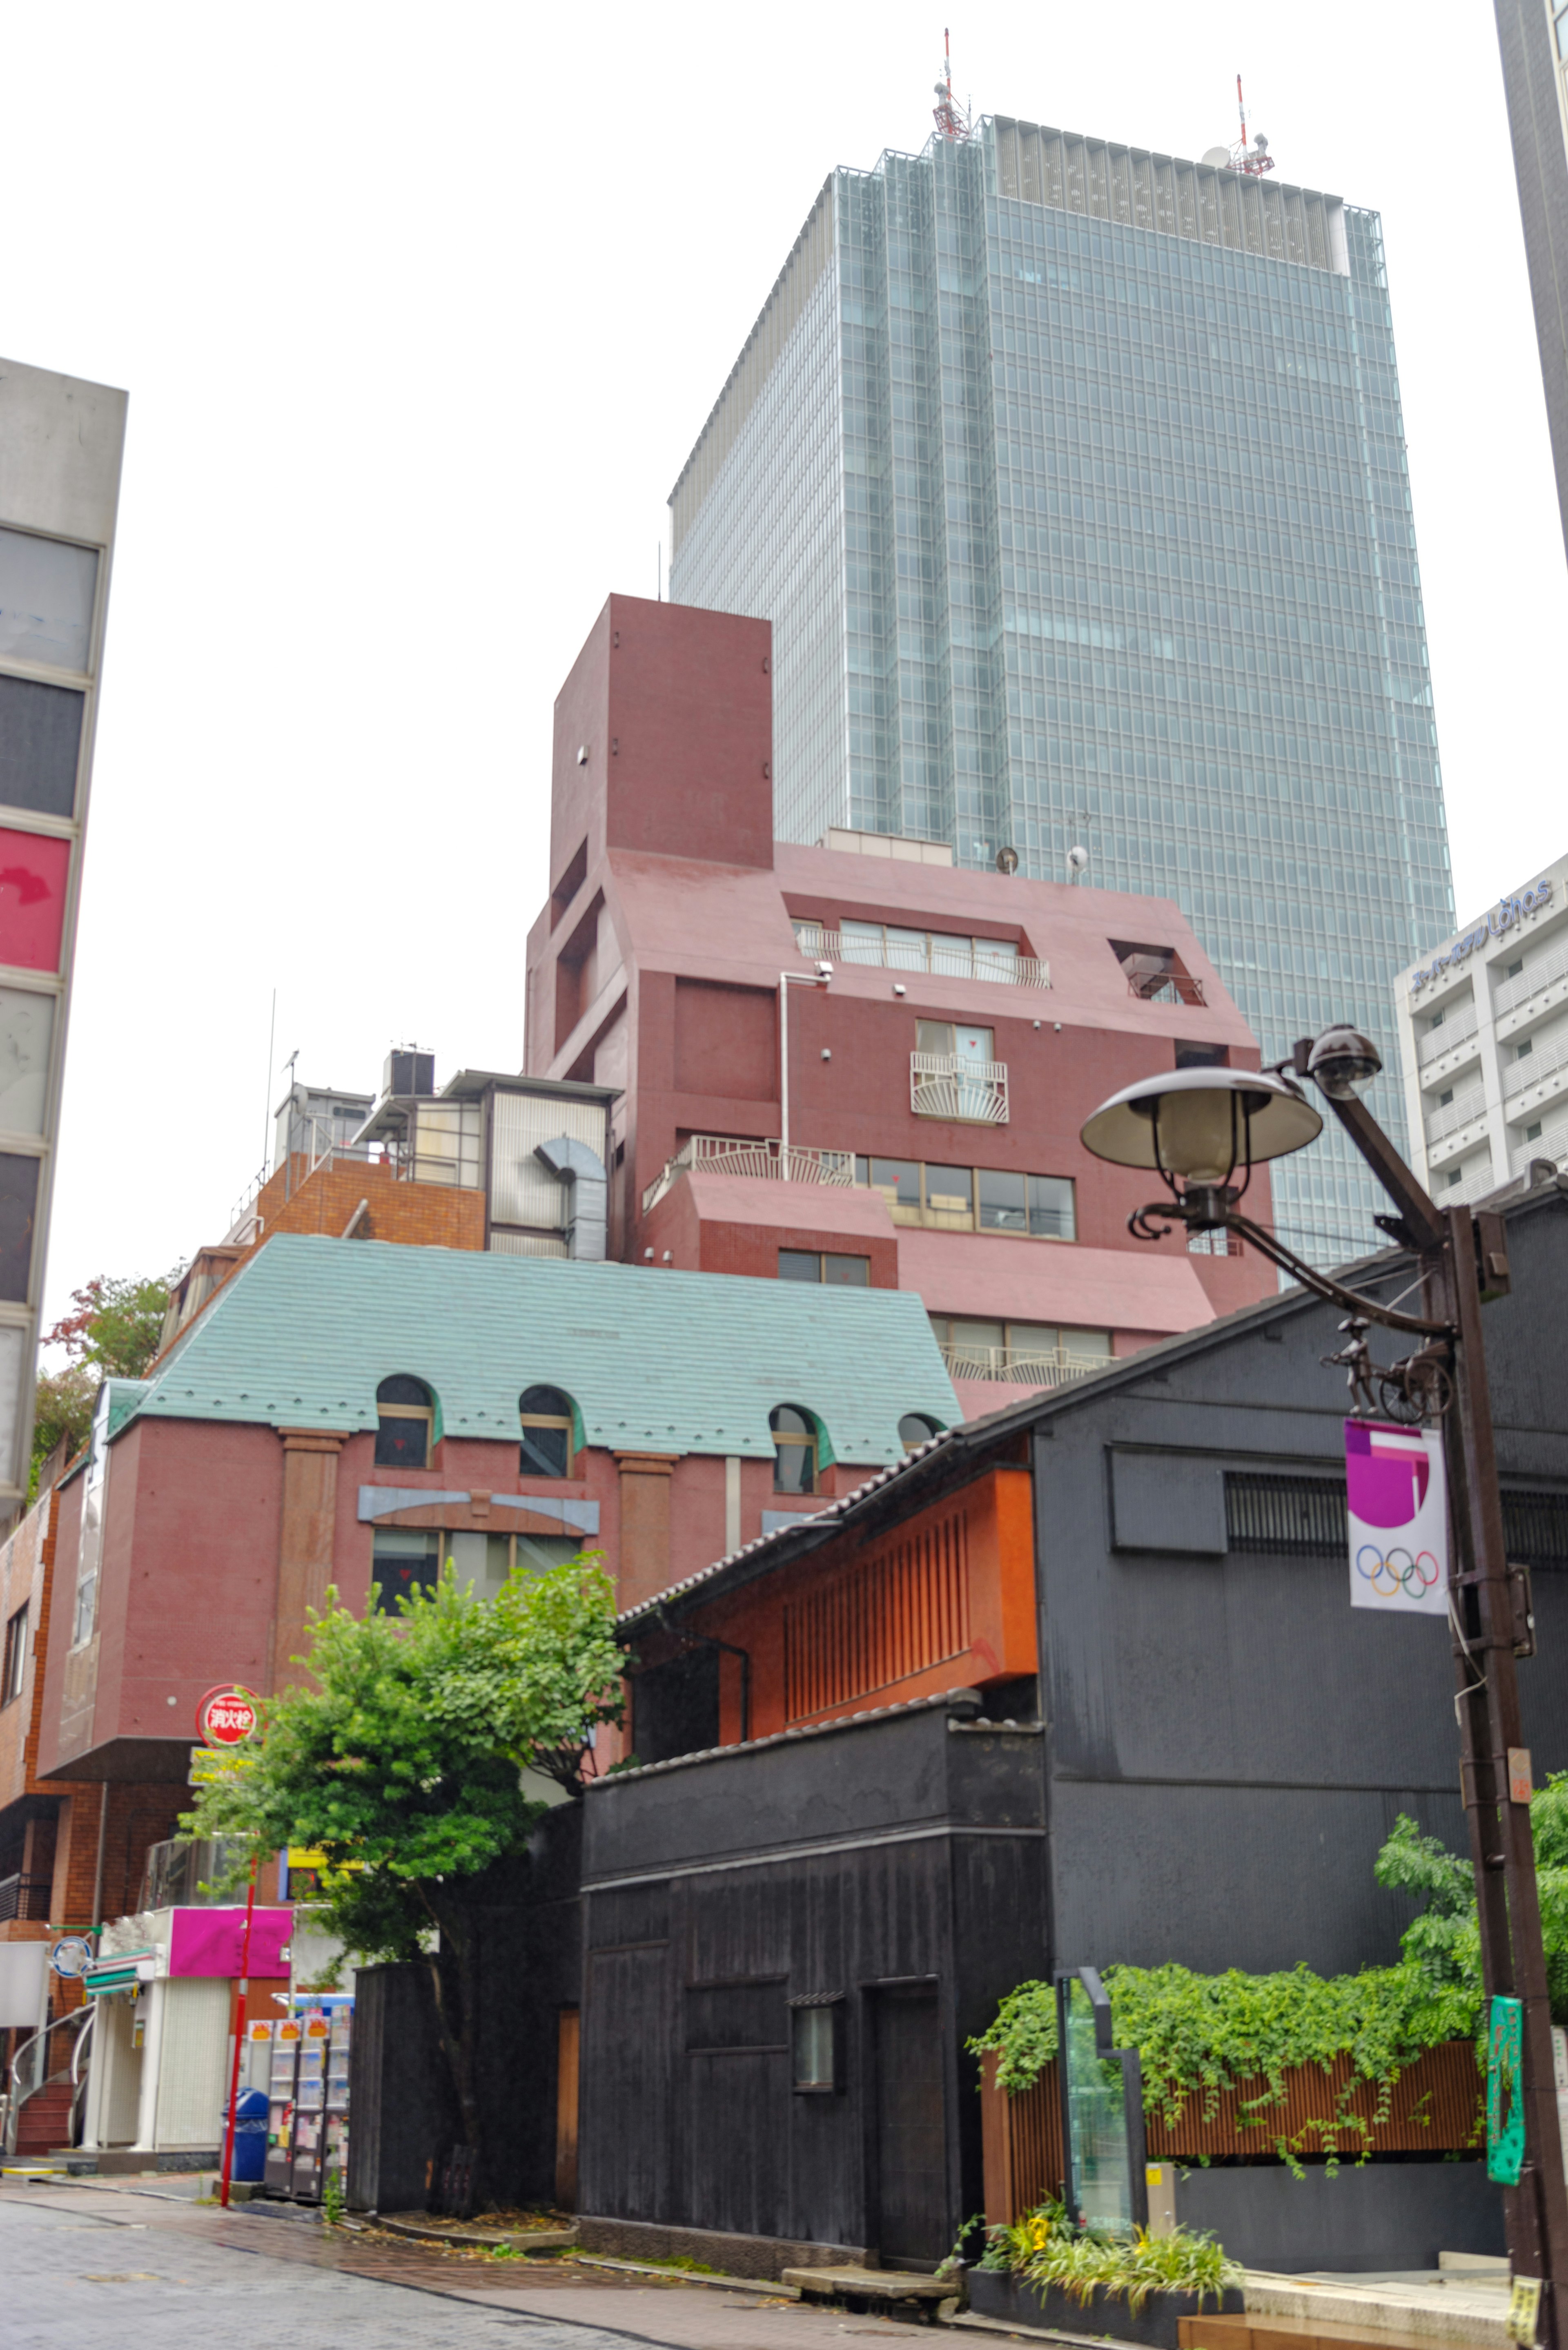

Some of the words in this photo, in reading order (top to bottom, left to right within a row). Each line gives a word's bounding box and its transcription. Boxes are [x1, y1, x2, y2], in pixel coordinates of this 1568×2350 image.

[1411, 926, 1486, 993] スーパーホテル
[210, 1708, 252, 1730] 消火栓
